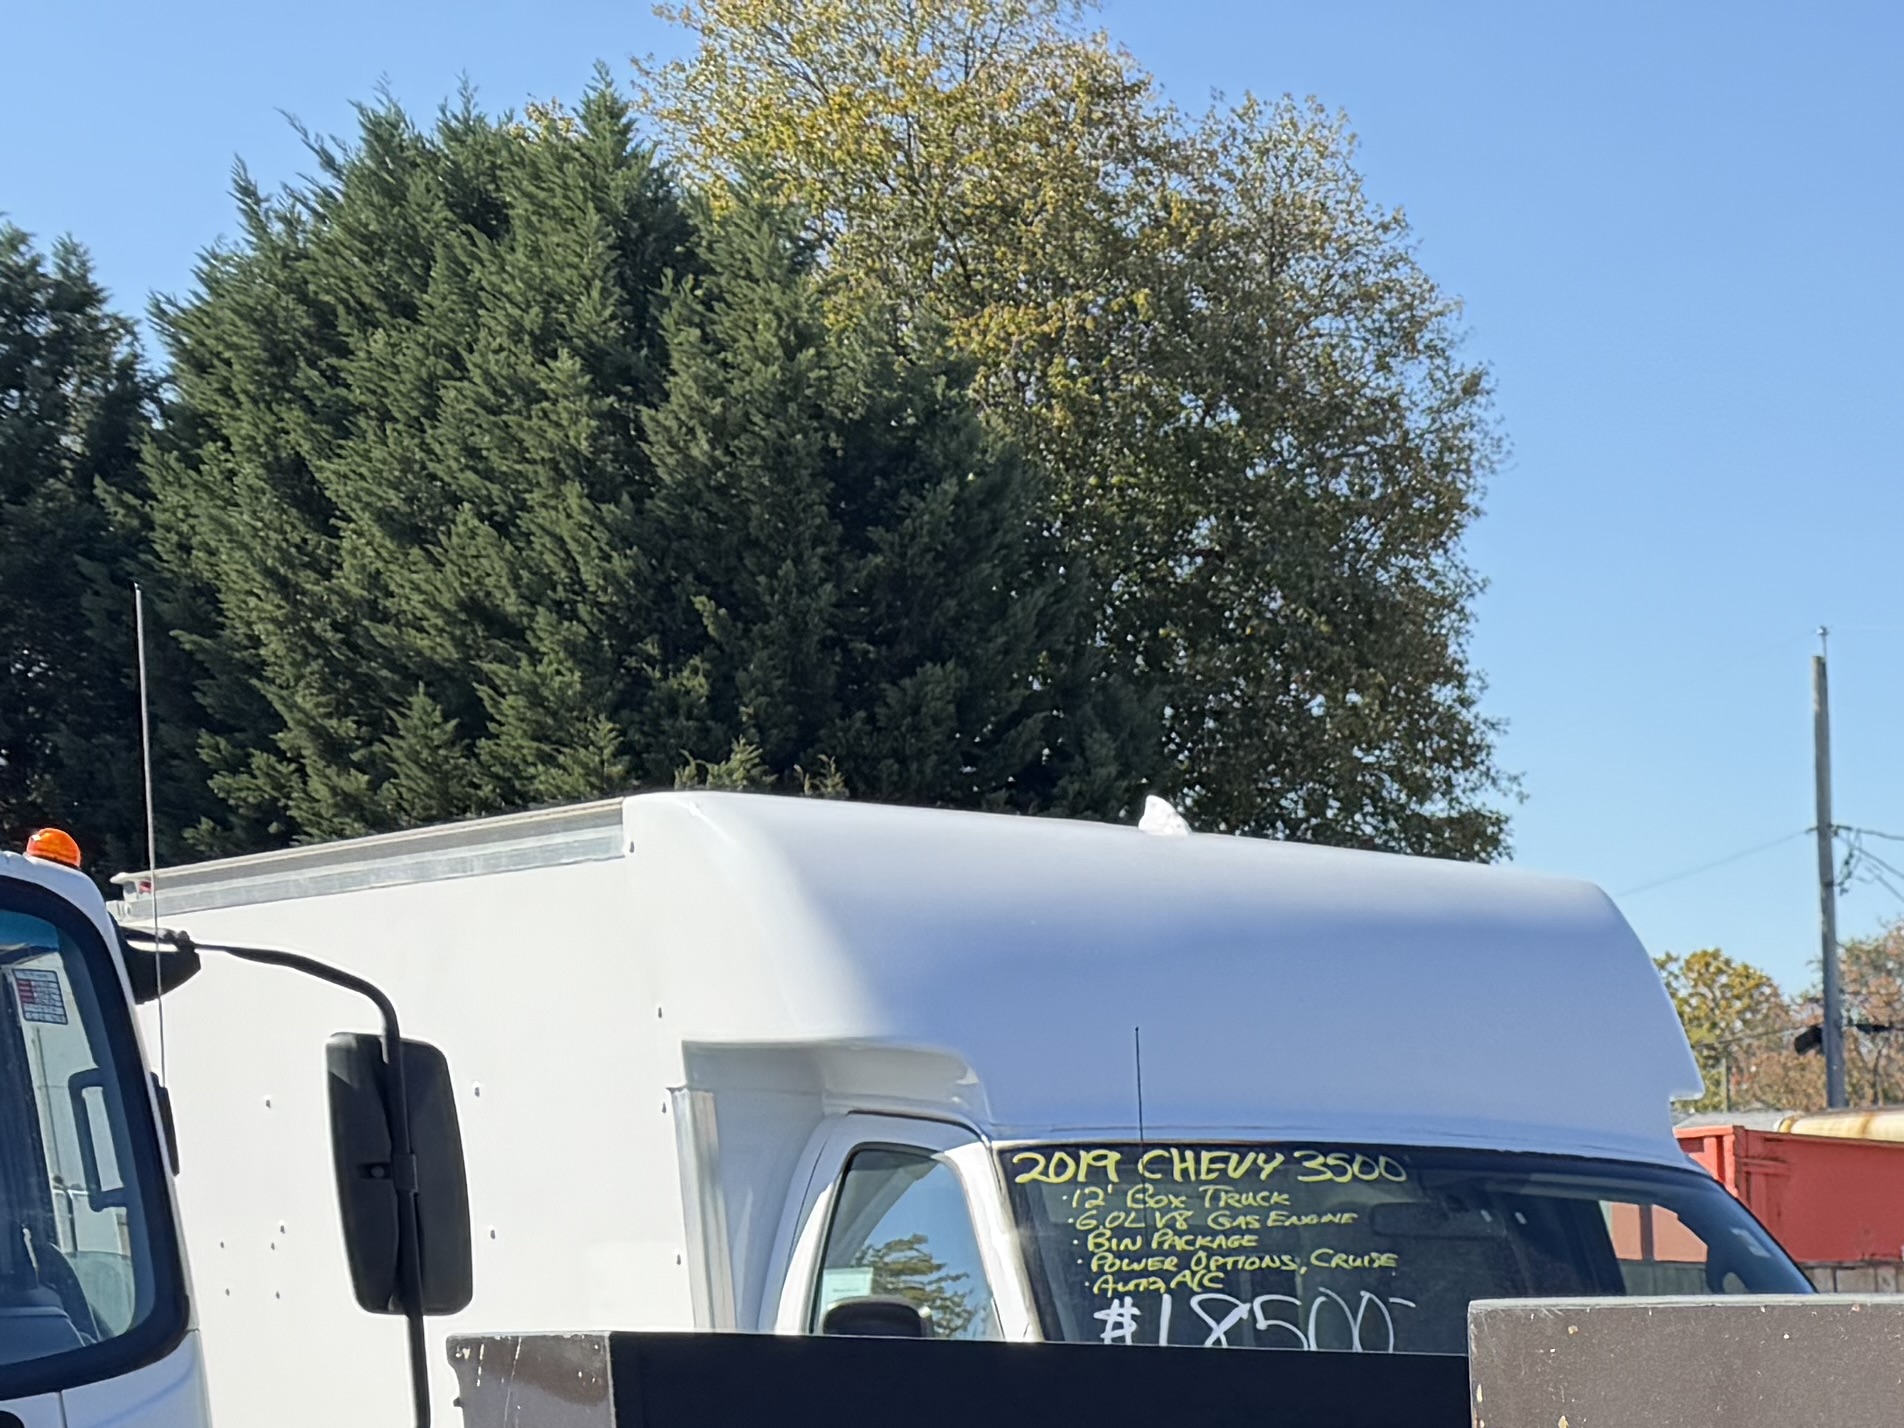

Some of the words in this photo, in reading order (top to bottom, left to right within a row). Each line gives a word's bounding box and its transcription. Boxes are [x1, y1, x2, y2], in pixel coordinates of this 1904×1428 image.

[1012, 1148, 1122, 1184] 2019
[1138, 1147, 1285, 1183] CHEVY
[1293, 1149, 1408, 1184] 3500
[1198, 1184, 1291, 1209] TRUCK
[1154, 1209, 1194, 1230] V8
[1206, 1209, 1262, 1231] GAS
[1087, 1229, 1143, 1253] BIN
[1151, 1227, 1260, 1251] PACKAGE
[1090, 1251, 1179, 1273] POWER
